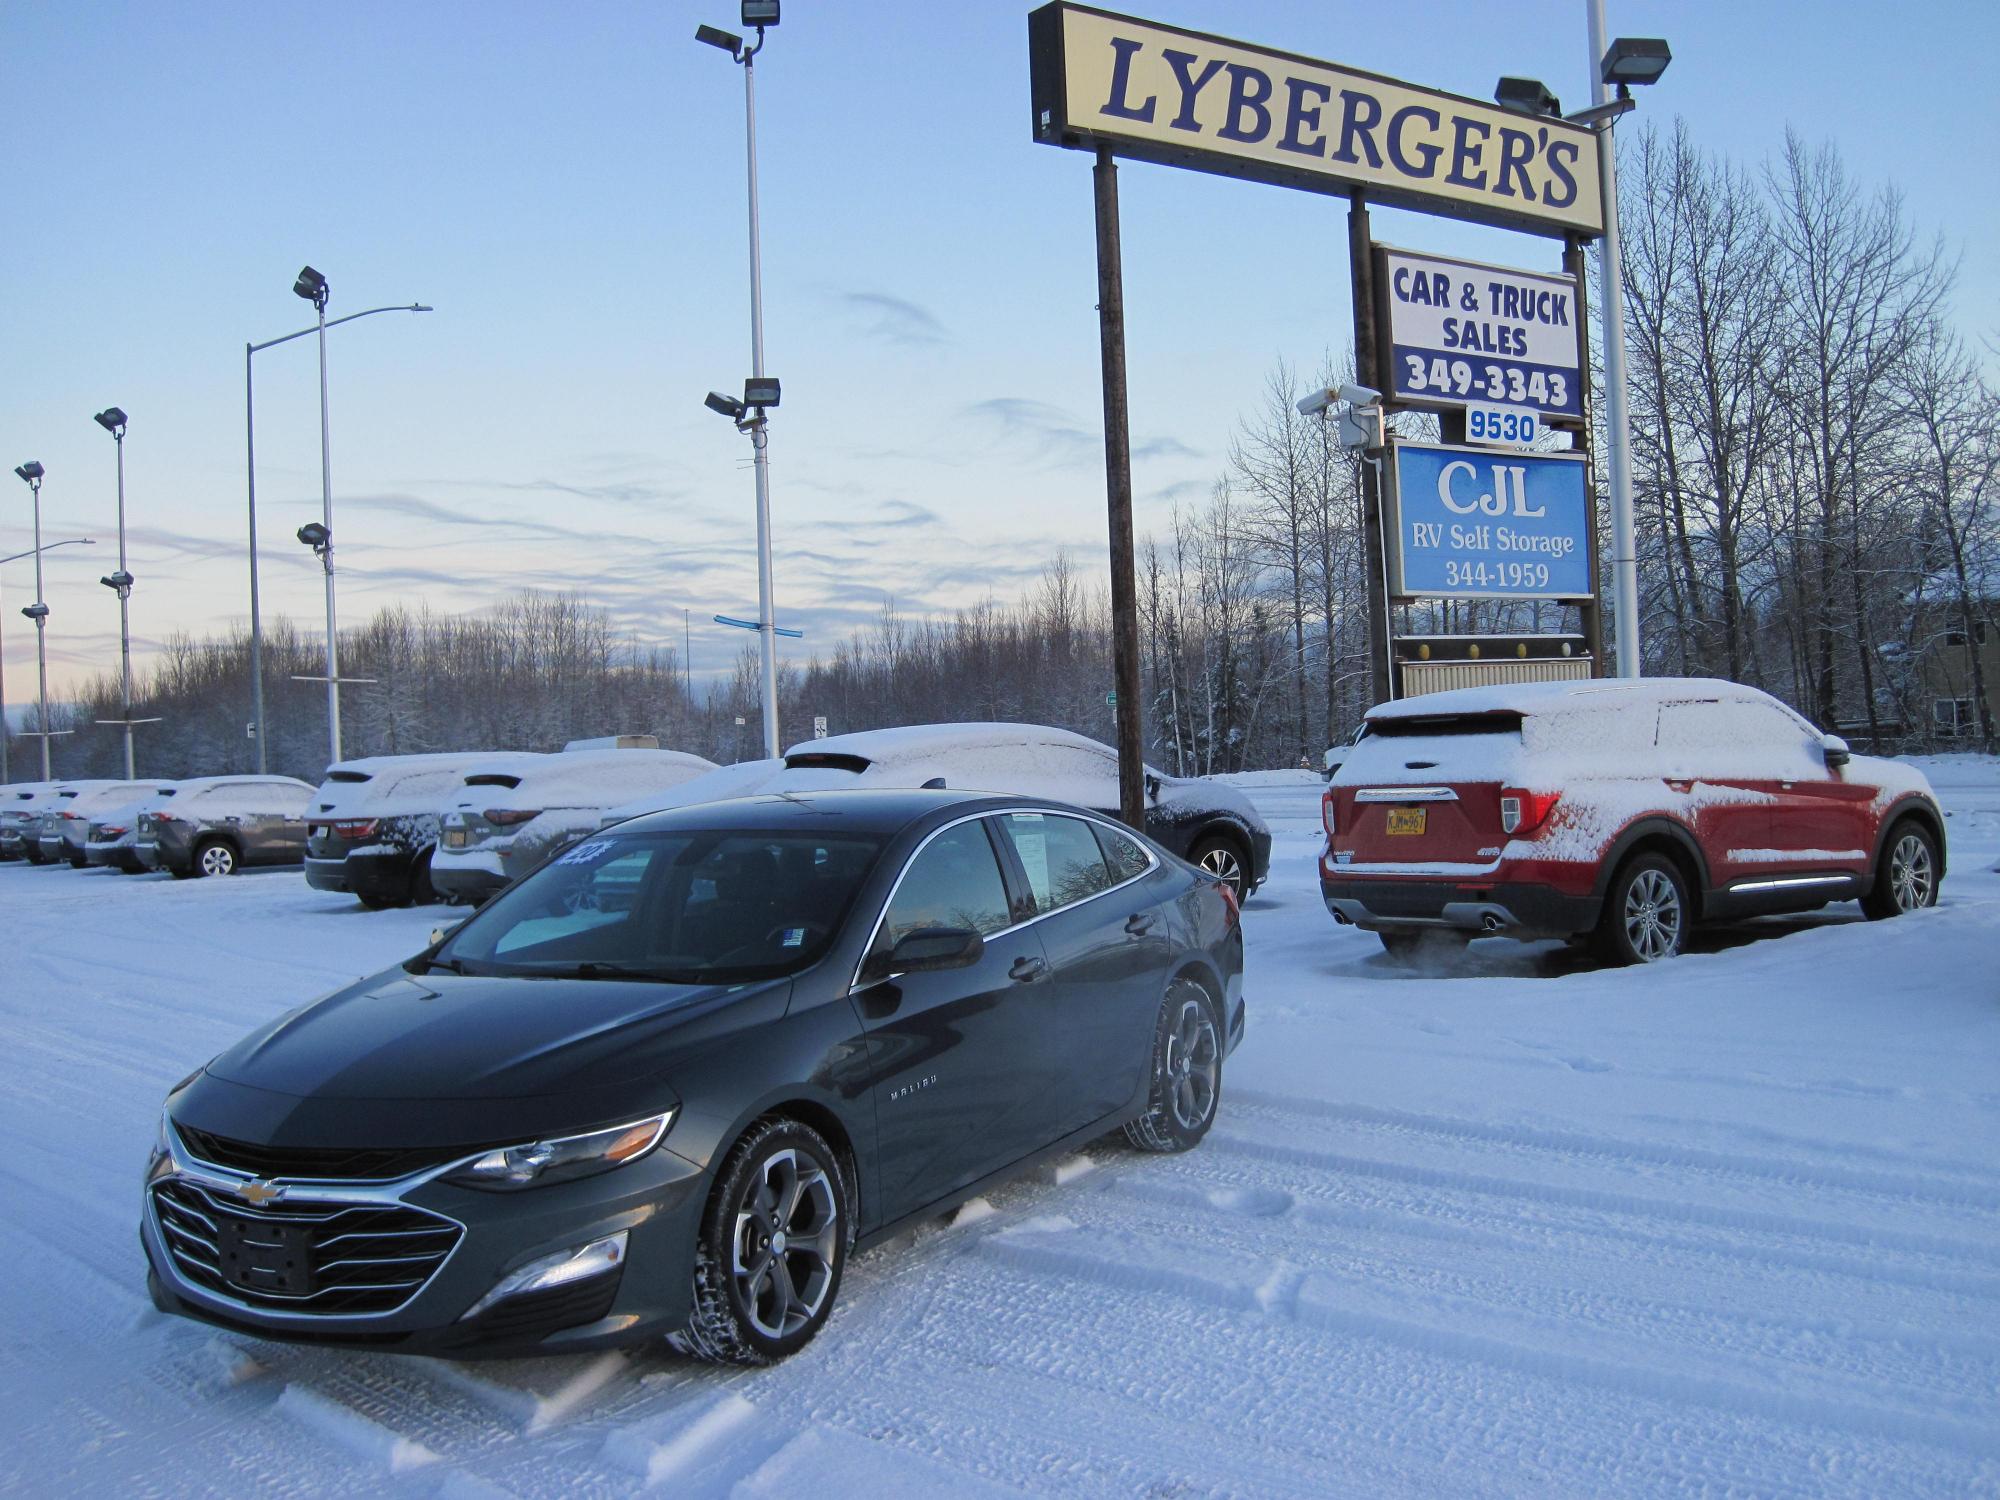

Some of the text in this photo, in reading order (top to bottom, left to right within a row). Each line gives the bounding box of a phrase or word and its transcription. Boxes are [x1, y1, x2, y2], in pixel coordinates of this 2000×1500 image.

[1100, 36, 1579, 208] LYBERGER'S
[1393, 267, 1568, 326] CAR & TRUCK
[1442, 317, 1528, 357] SALES
[1405, 355, 1567, 407] 349-3343
[1470, 410, 1535, 442] 9530
[1438, 460, 1545, 518] CJL
[1412, 522, 1574, 557] RV Self Storage
[1445, 561, 1549, 588] 344-1959
[890, 1074, 937, 1101] MALIBU
